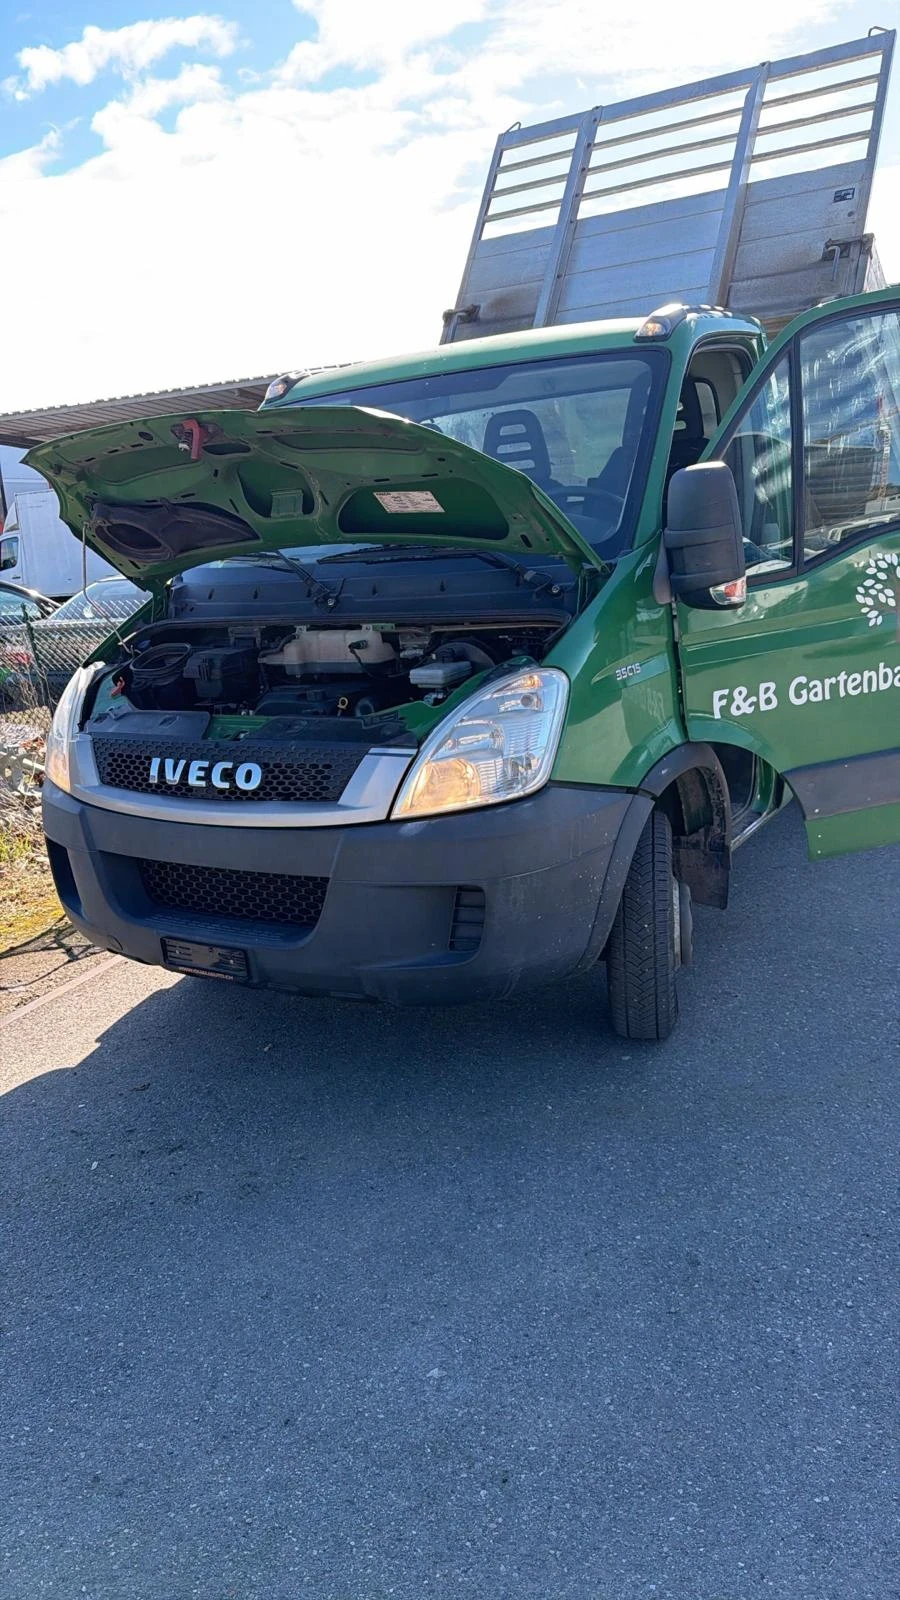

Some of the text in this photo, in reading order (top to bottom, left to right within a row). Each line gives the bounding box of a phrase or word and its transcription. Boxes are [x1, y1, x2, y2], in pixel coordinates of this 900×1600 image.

[615, 662, 641, 681] 35C15
[712, 681, 778, 719] F&B
[149, 757, 262, 791] IVECO
